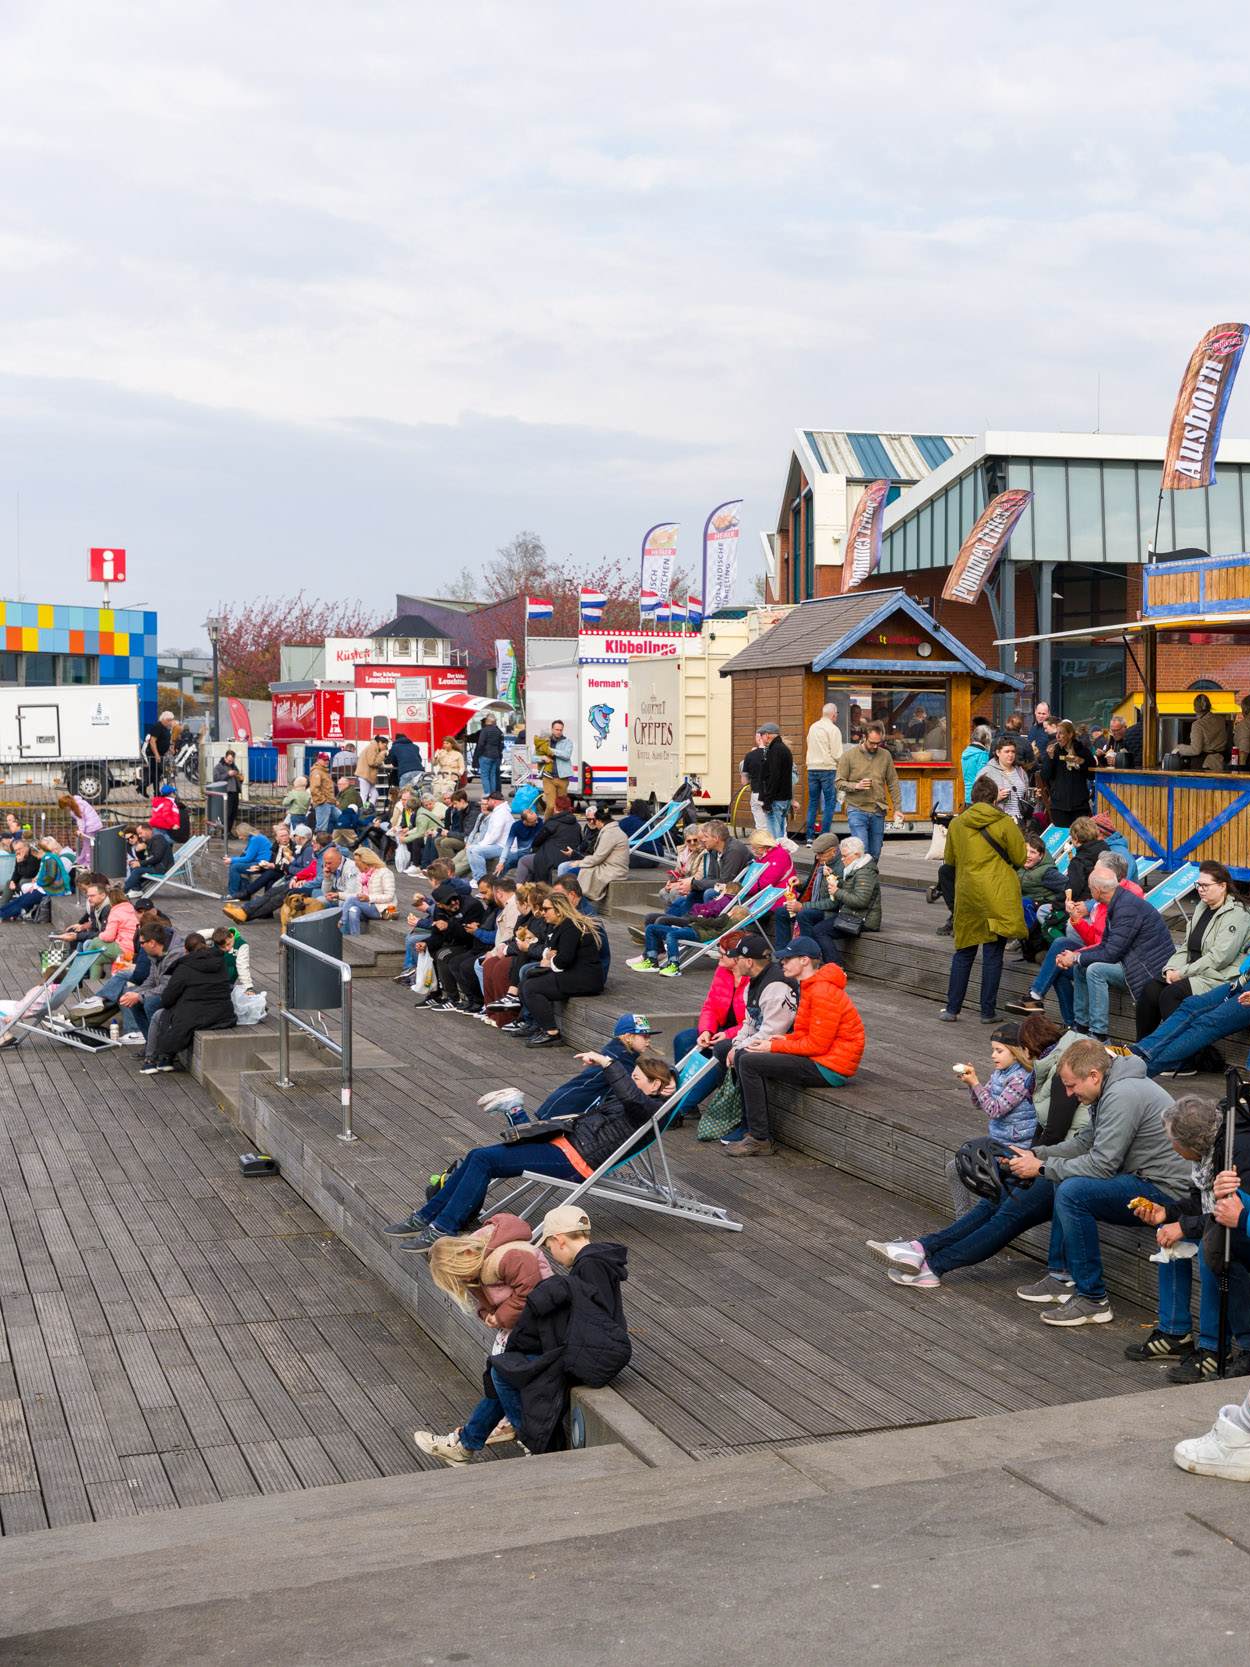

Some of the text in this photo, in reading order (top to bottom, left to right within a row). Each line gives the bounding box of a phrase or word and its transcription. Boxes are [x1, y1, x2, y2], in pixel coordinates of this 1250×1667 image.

[1174, 359, 1224, 480] Ausborn
[649, 569, 658, 592] ISCH
[951, 542, 995, 602] Pommes
[866, 634, 921, 644] Frittenbude
[588, 678, 629, 688] Herman's
